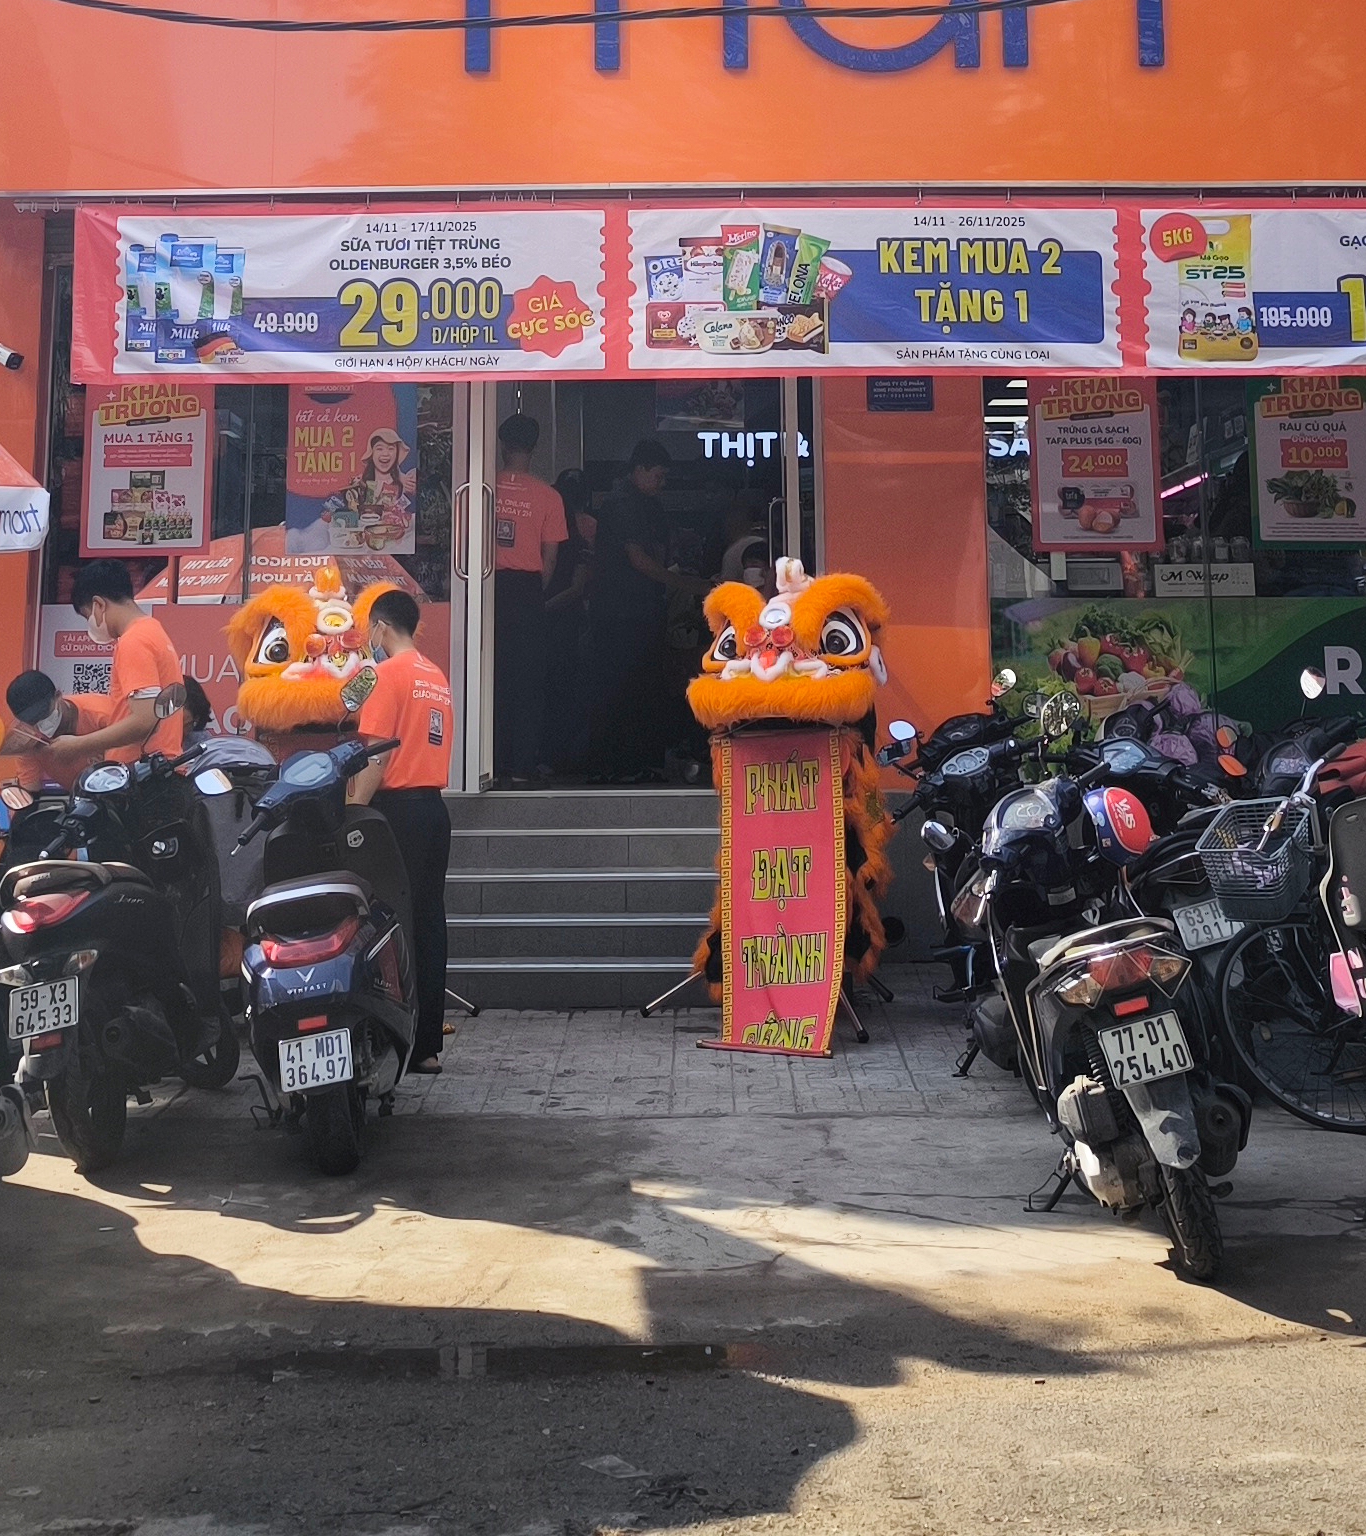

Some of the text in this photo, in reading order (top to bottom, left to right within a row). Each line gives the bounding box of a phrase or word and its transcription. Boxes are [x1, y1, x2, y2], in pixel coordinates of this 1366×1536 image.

[366, 221, 477, 233] 14/11 17/11/2025
[914, 216, 1025, 227] 14/11 26/11/2025
[341, 236, 500, 253] SỮA TƯƠI TIỆT TRÙNG
[727, 229, 757, 244] Merino
[1163, 227, 1192, 247] 5KG
[330, 254, 511, 271] OLDENBURGER 3,5% BÉO
[879, 240, 1062, 274] KEM MUA 2
[1186, 266, 1245, 279] ST25
[787, 263, 811, 305] ELONA
[528, 290, 563, 313] GIÁ
[914, 281, 1028, 334] TẶNG 1
[254, 312, 318, 333] 49.900
[339, 280, 501, 347] 29.000
[507, 307, 595, 340] CỰC SỐC
[1260, 307, 1332, 327] 195.000
[170, 327, 200, 340] Milk
[432, 323, 498, 348] Đ/HỘP 1L
[335, 354, 500, 370] GIỚI HẠN 4 HỘP/ KHÁCH/ NGÀY
[896, 346, 1050, 362] SẢN PHẨM TẶNG CÙNG LOẠI
[124, 385, 178, 402] KHAI
[1064, 377, 1118, 396] KHAI
[1283, 377, 1338, 393] KHAI
[101, 397, 197, 421] TRƯƠNG
[1043, 391, 1140, 415] TRƯƠNG
[1262, 390, 1359, 413] TRƯƠNG
[333, 408, 361, 423] kem
[295, 426, 354, 447] MUA 2
[1058, 425, 1129, 436] TRỨNG GÀ SẠCH
[1279, 420, 1346, 433] RAU CỦ QUẢ
[104, 431, 194, 446] MUA 1 TẶNG 1
[1070, 437, 1092, 445] PLUS
[697, 431, 778, 467] THỊT
[1288, 446, 1341, 464] 10.000
[295, 448, 356, 476] TẶNG 1
[1068, 455, 1122, 472] 24.000
[1185, 569, 1230, 584] Wap
[743, 749, 821, 816] PHÁT
[750, 846, 812, 911] ĐẠT
[741, 922, 828, 990] THÀNH
[20, 982, 68, 1012] 59-X3
[15, 1004, 72, 1035] 645.33
[286, 1057, 347, 1088] 364.97
[1113, 1043, 1187, 1086] 254.40
